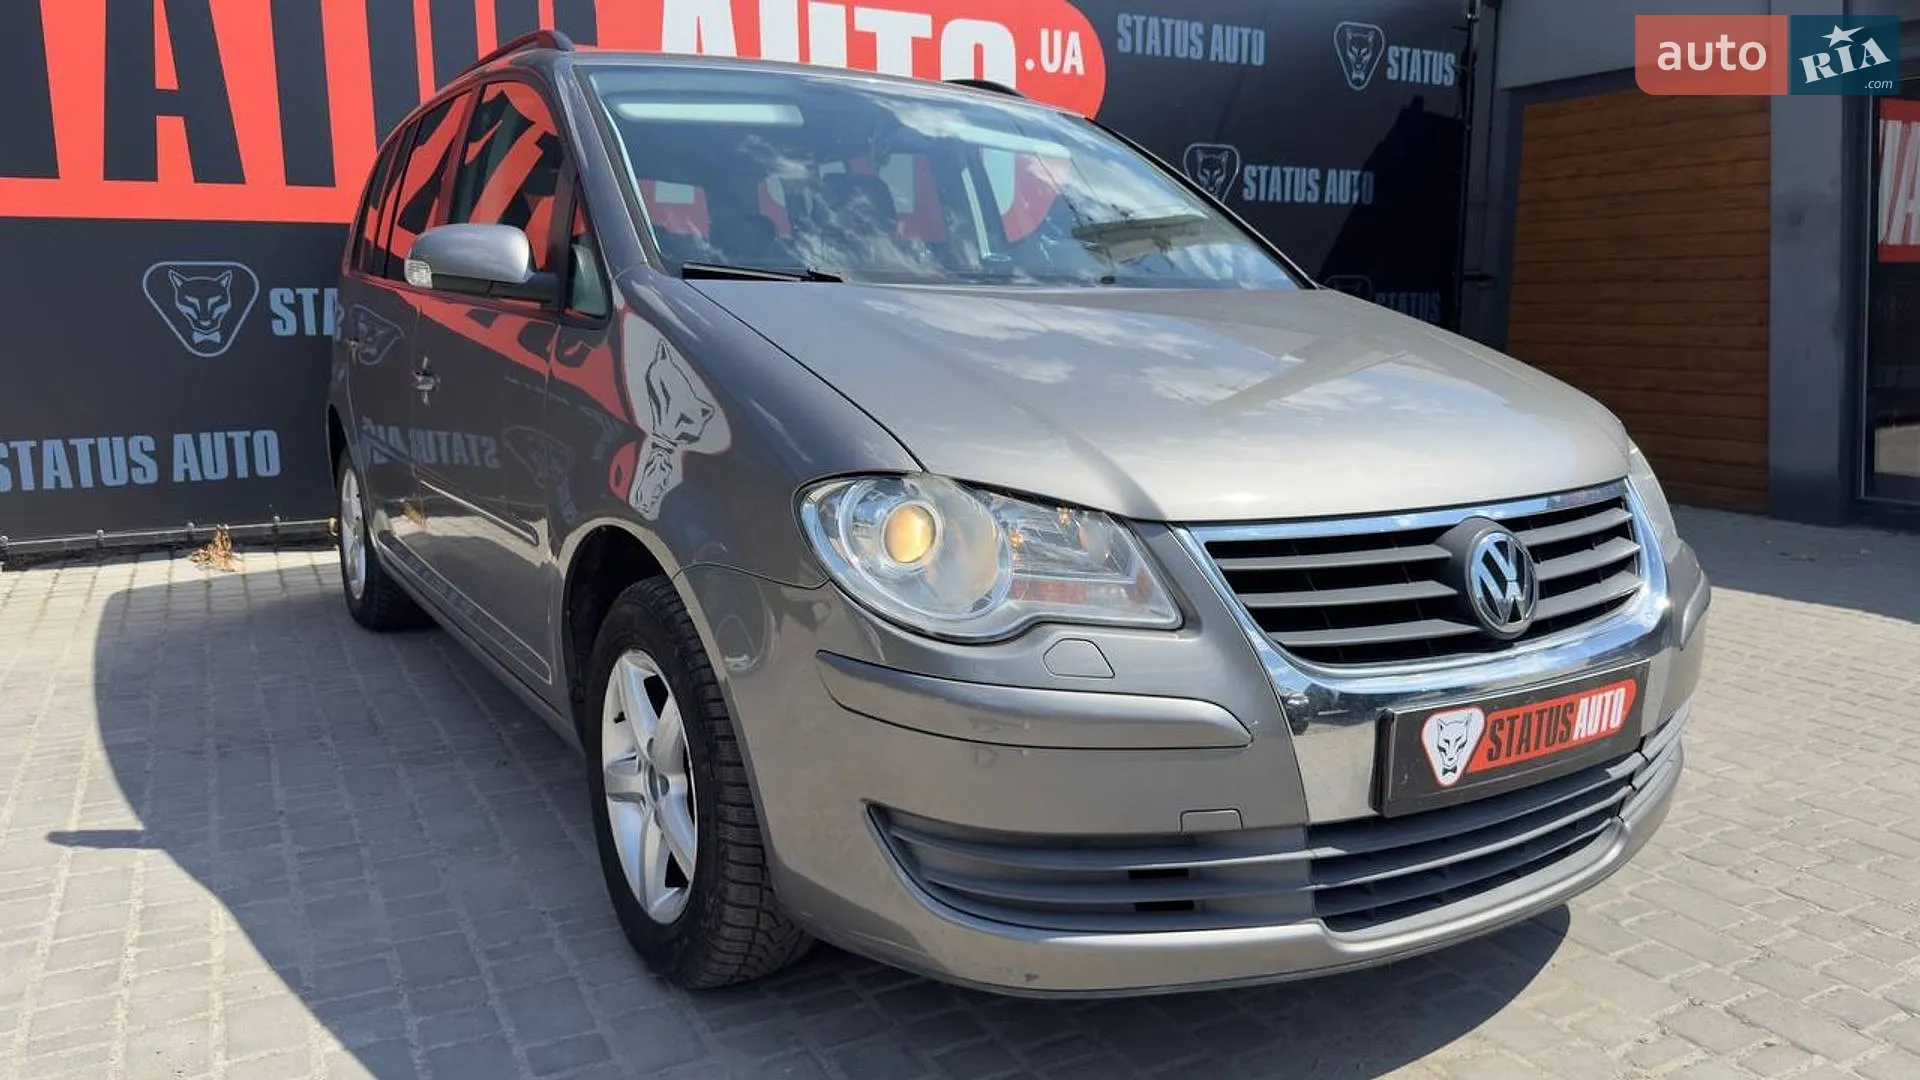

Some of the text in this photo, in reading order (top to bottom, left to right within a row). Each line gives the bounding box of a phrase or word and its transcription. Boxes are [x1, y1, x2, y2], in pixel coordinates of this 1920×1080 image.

[1117, 13, 1265, 66] STATUS AUTO
[1387, 45, 1456, 86] STATUS
[1243, 164, 1375, 206] STATUS AUTO
[172, 429, 281, 483] AUTO
